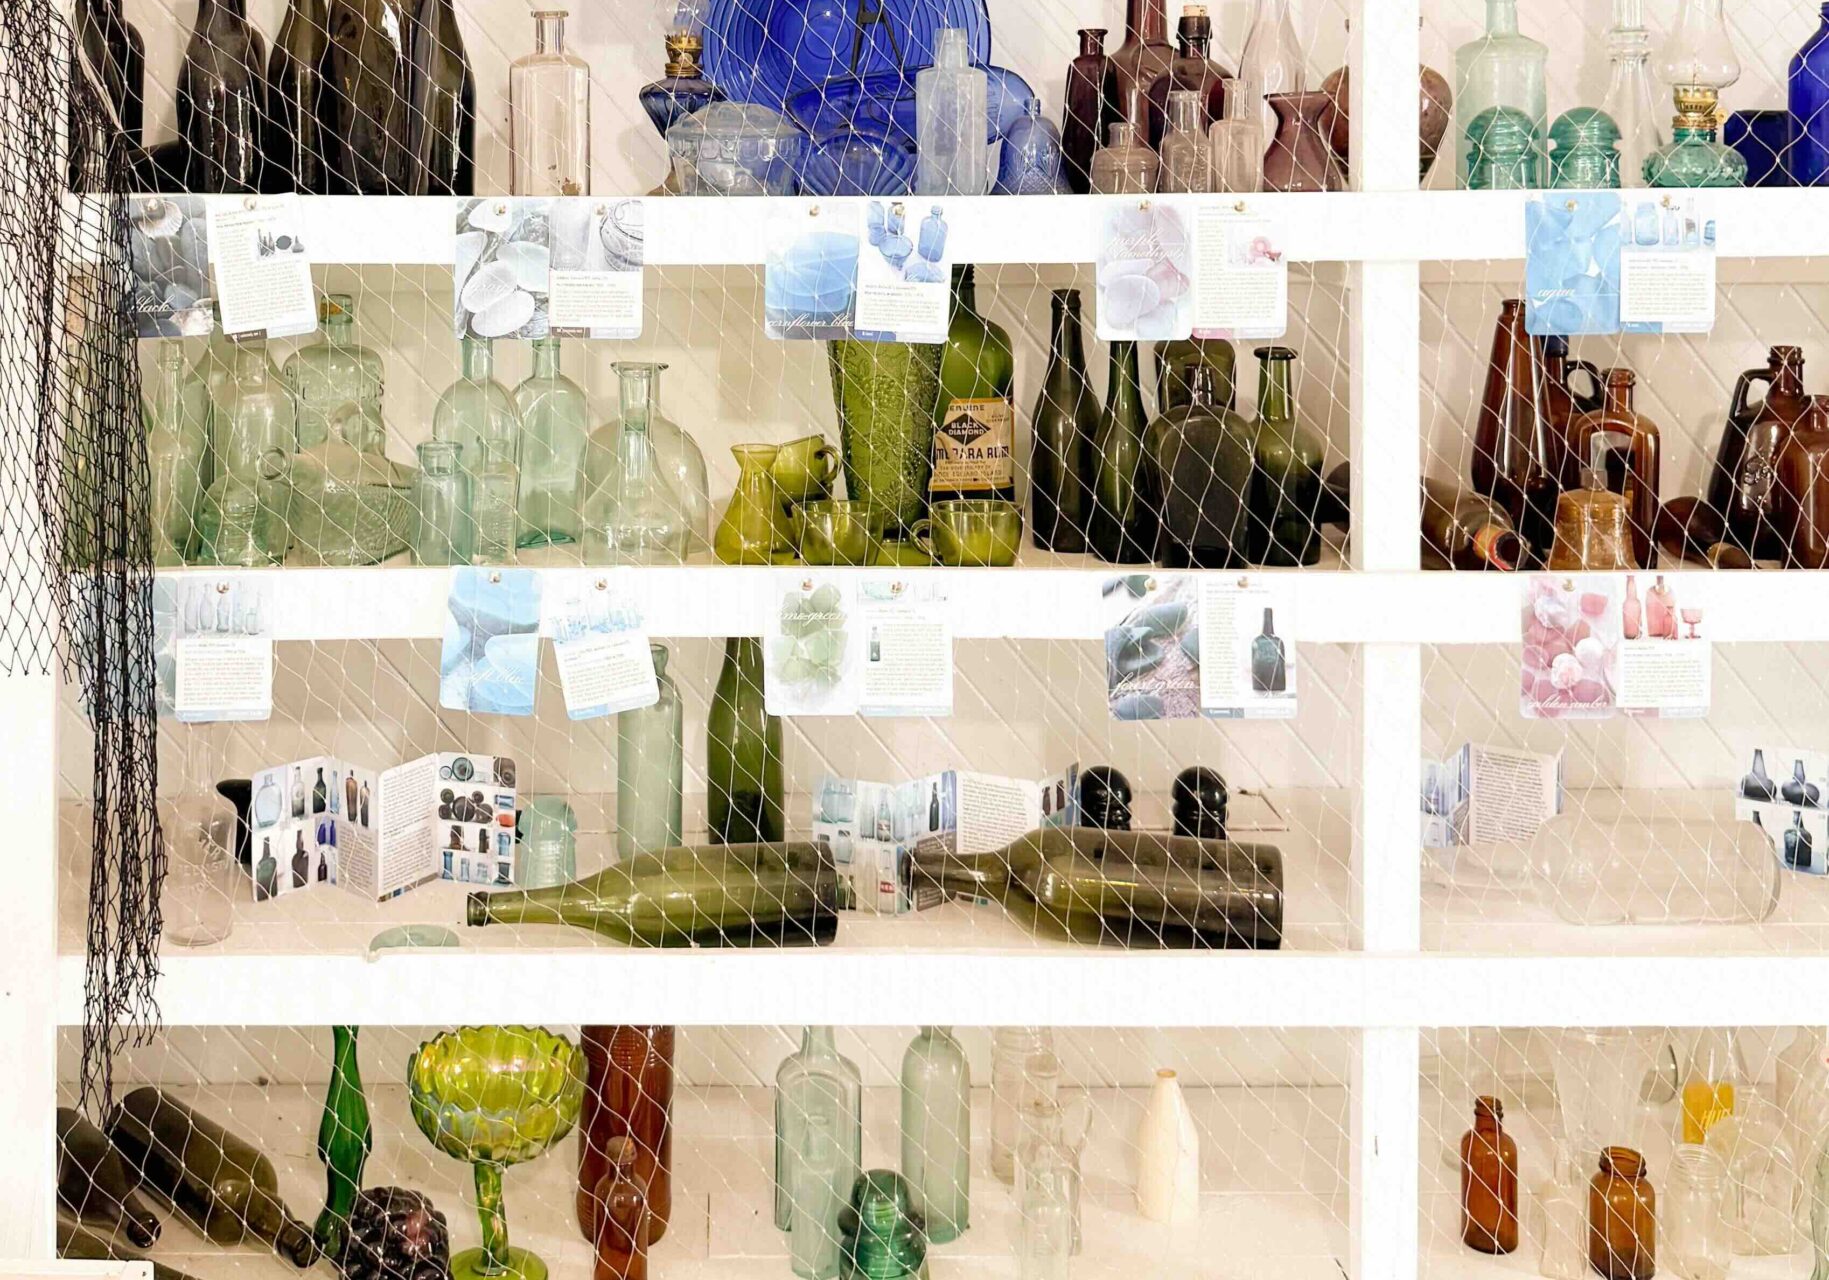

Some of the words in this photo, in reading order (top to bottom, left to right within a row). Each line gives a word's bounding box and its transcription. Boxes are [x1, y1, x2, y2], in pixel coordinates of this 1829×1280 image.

[132, 295, 175, 313] black
[768, 312, 826, 332] cornflower
[830, 312, 854, 327] blue
[950, 421, 979, 429] BLACK
[948, 428, 985, 436] DIAMOND
